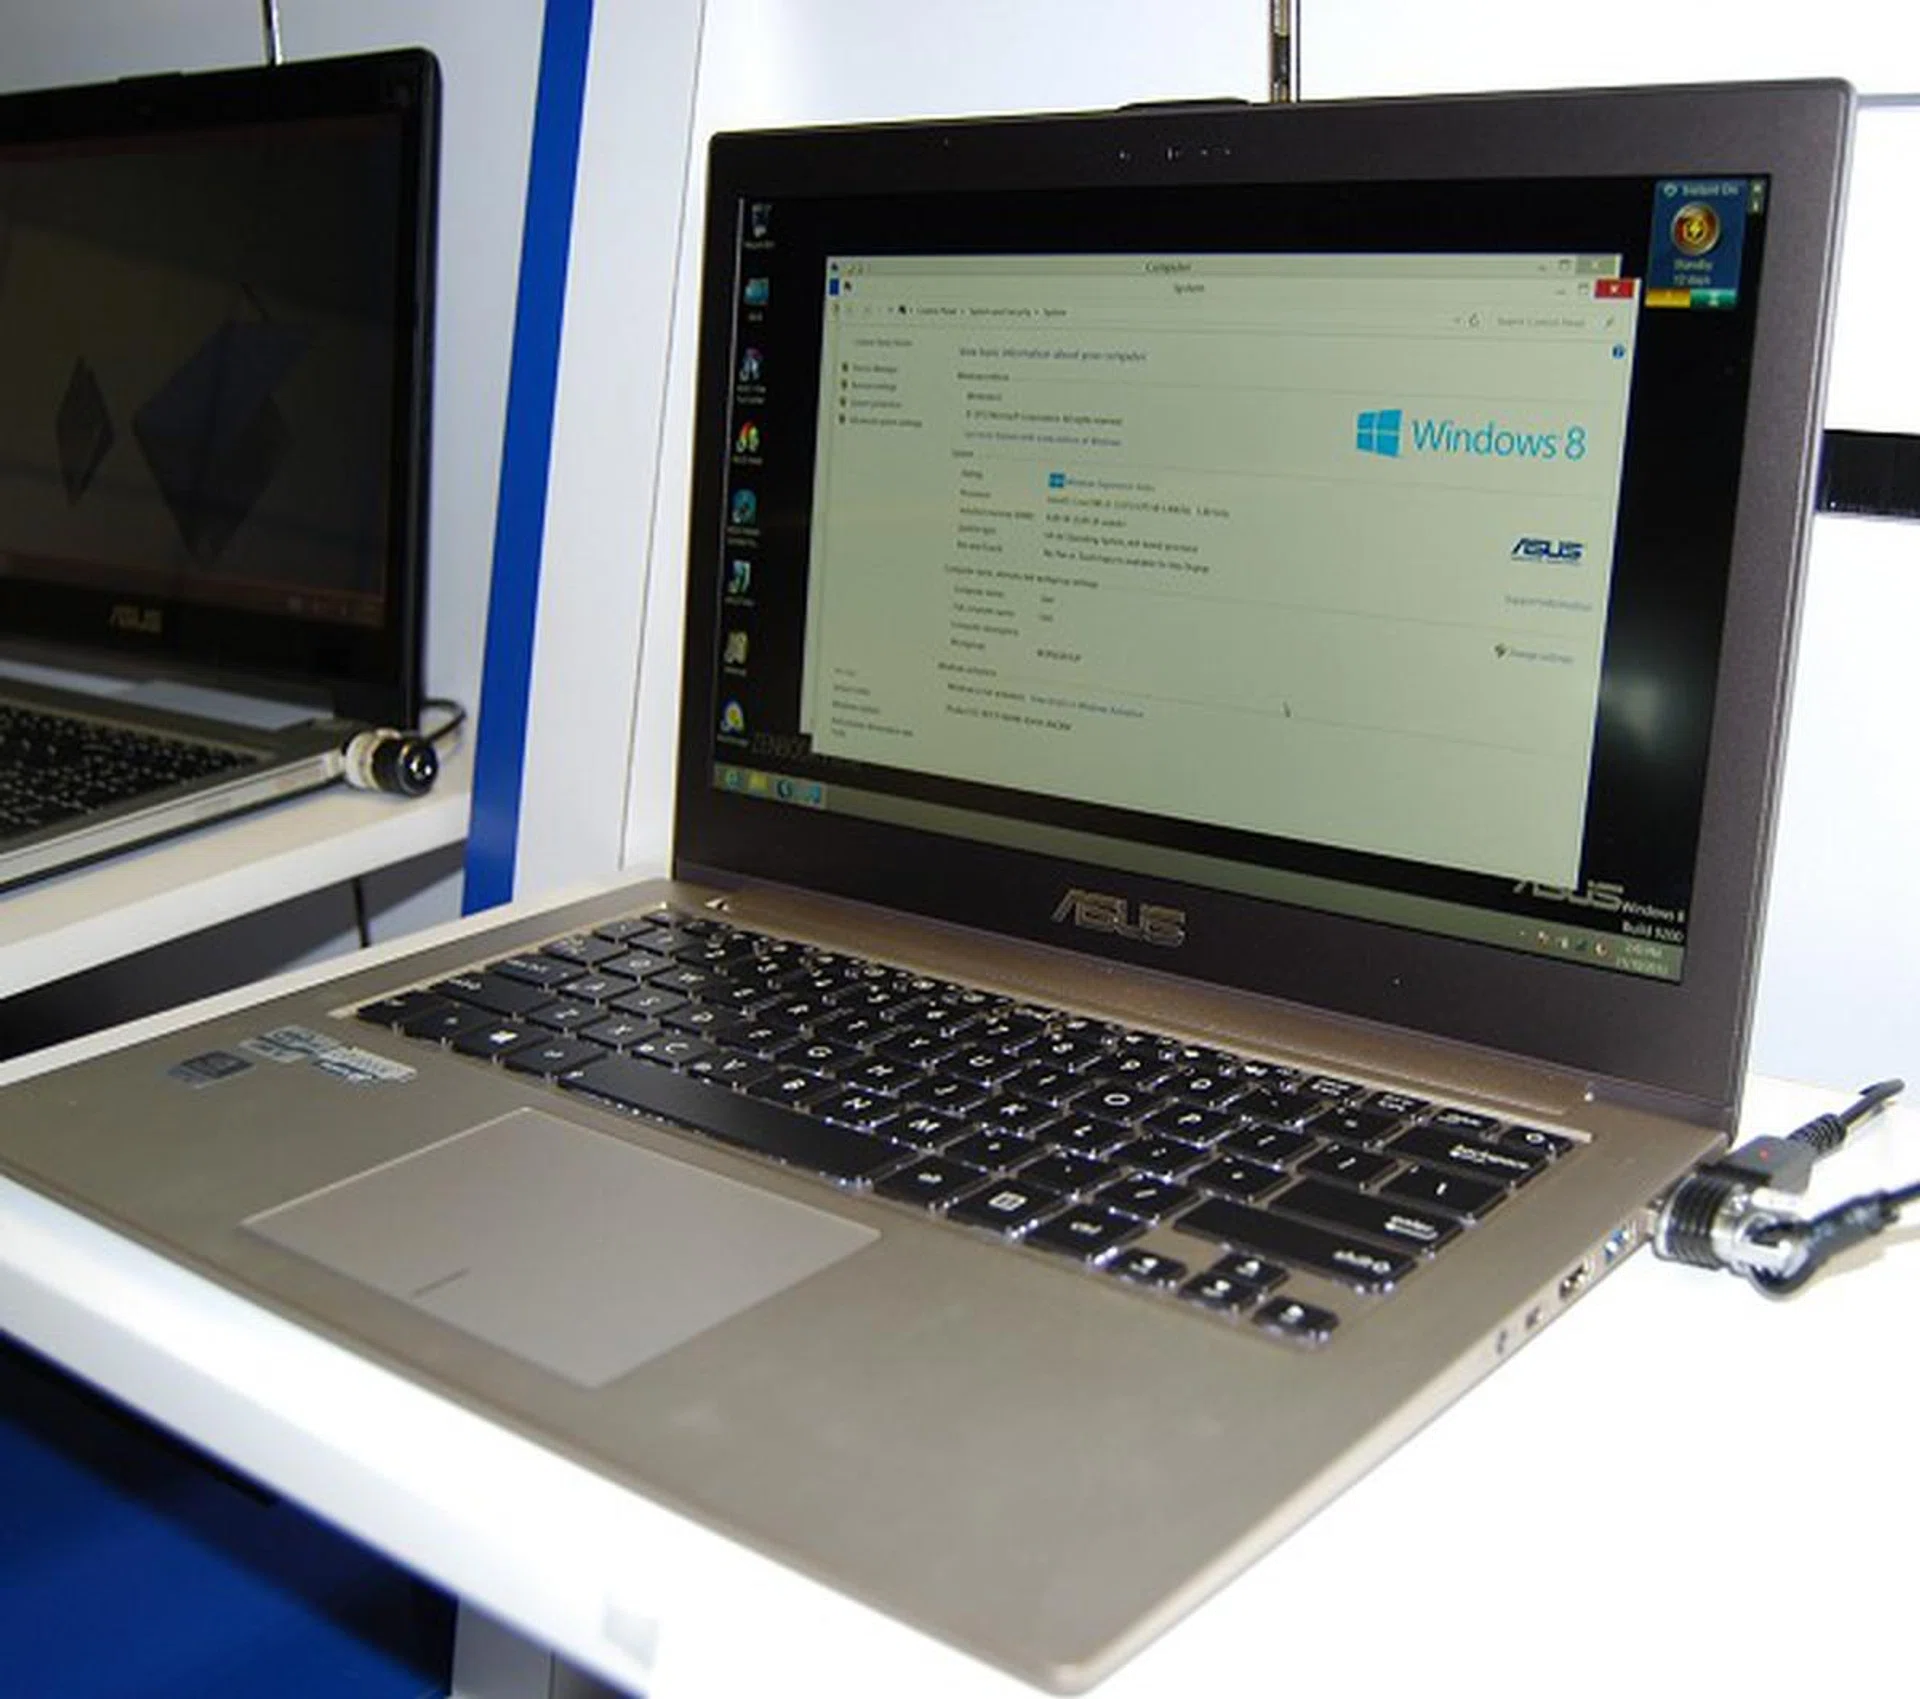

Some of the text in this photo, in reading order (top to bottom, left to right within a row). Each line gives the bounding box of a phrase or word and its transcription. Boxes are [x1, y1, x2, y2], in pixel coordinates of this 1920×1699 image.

[1411, 418, 1587, 461] Windows 8
[1511, 537, 1584, 558] ASUS
[1051, 888, 1187, 948] ASUS
